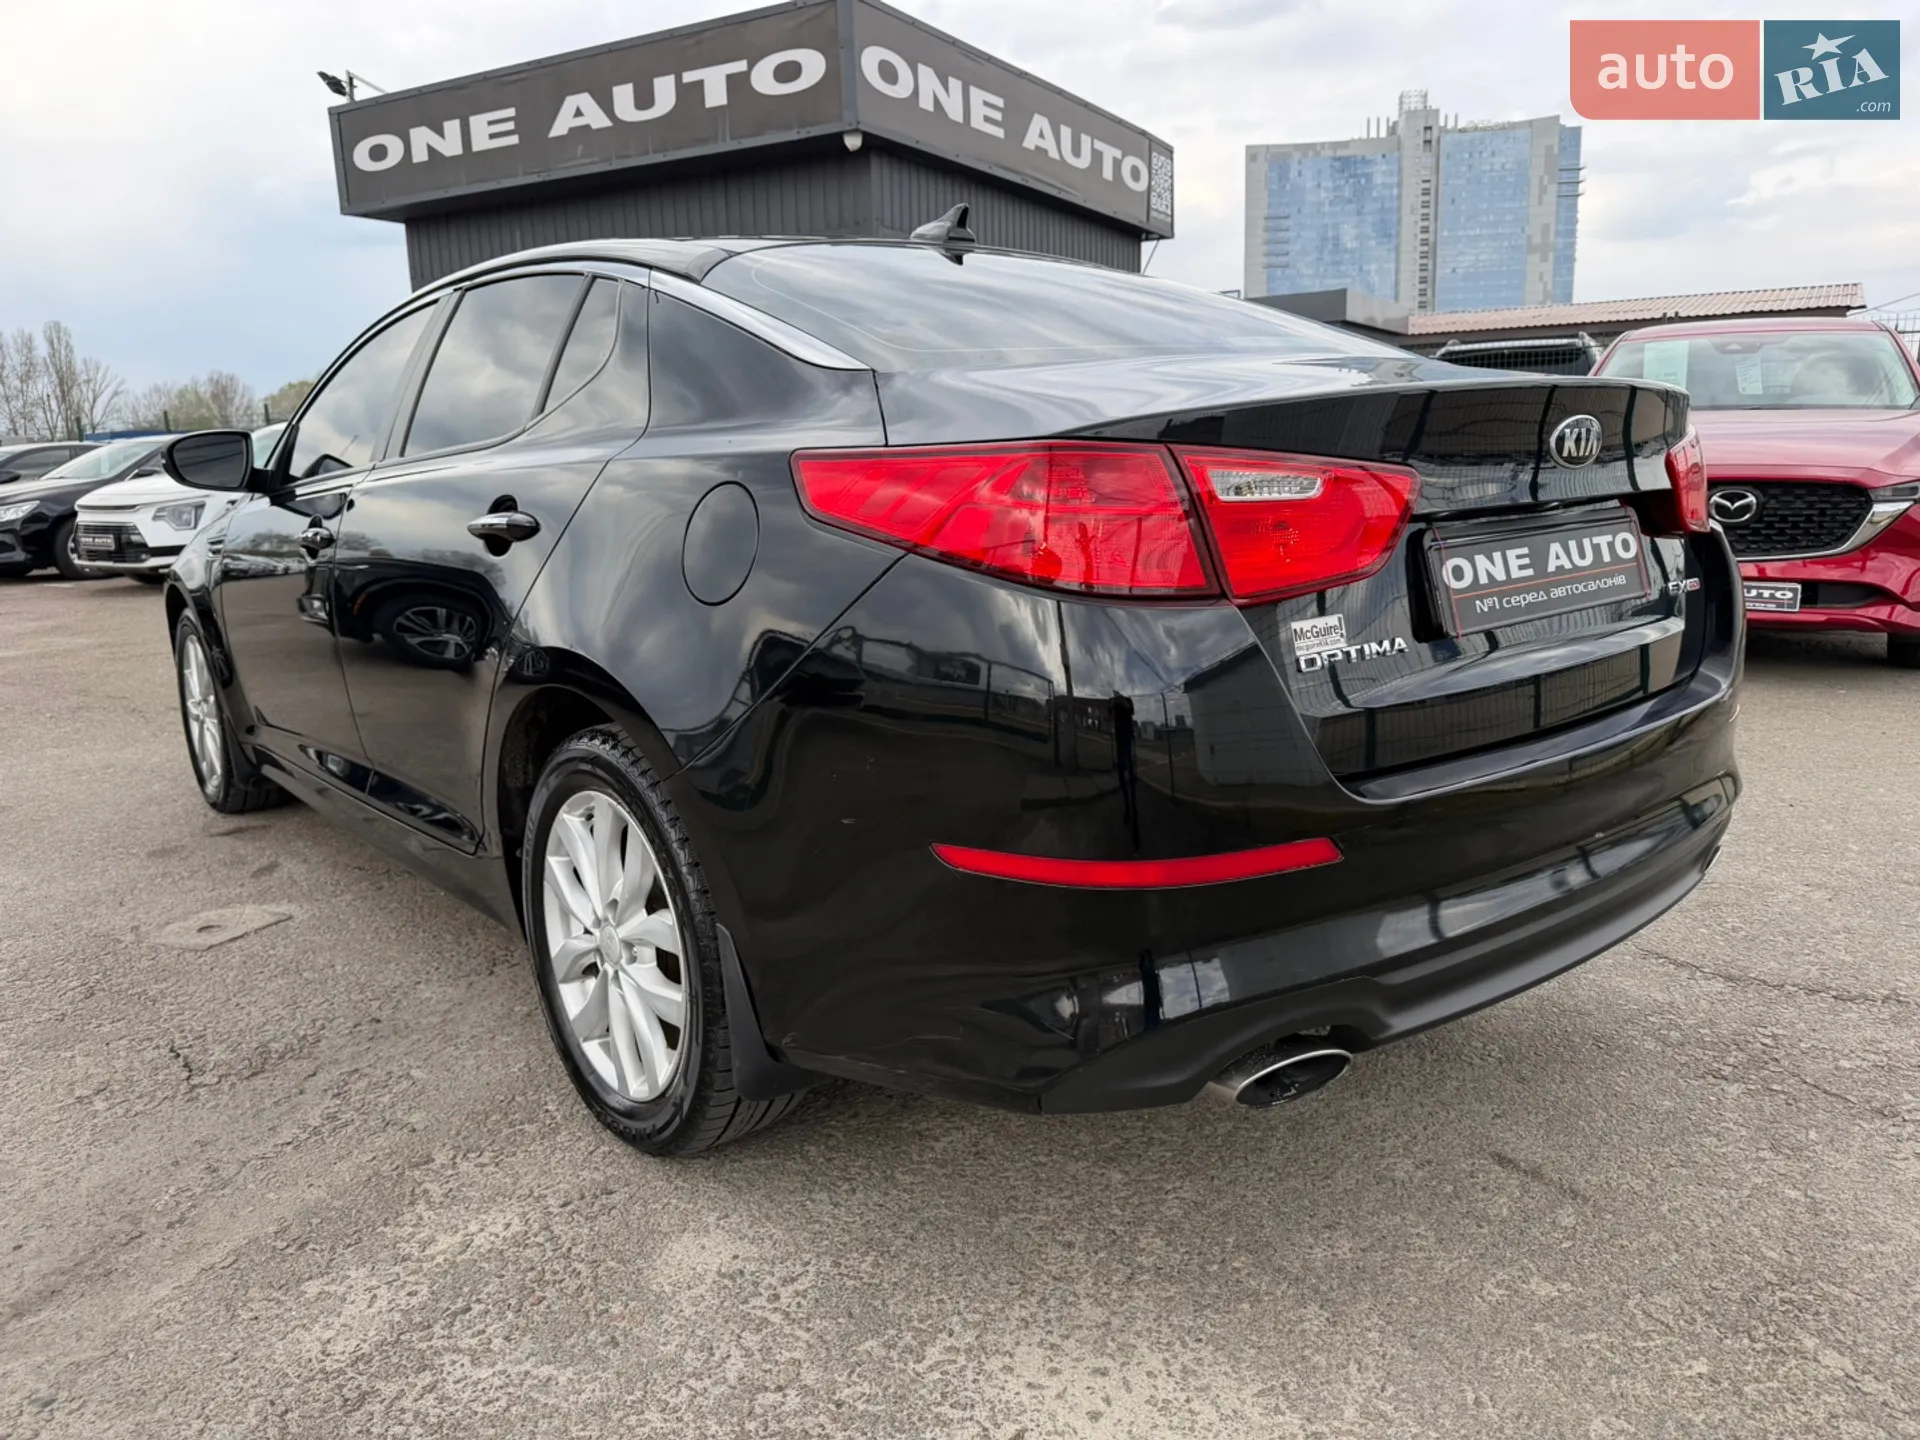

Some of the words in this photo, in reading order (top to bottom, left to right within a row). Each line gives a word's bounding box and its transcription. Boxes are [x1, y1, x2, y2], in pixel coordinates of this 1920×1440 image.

[353, 107, 520, 172] ONE
[548, 48, 827, 138] AUTO
[860, 45, 1005, 139] ONE
[1022, 112, 1149, 193] AUTO
[1562, 427, 1598, 457] KIA
[1442, 547, 1534, 590] ONE
[1547, 532, 1638, 573] AUTO
[1503, 590, 1547, 608] серед
[1550, 573, 1627, 599] автосалонів
[1744, 588, 1794, 599] UTO
[1297, 637, 1410, 673] OPTIMA
